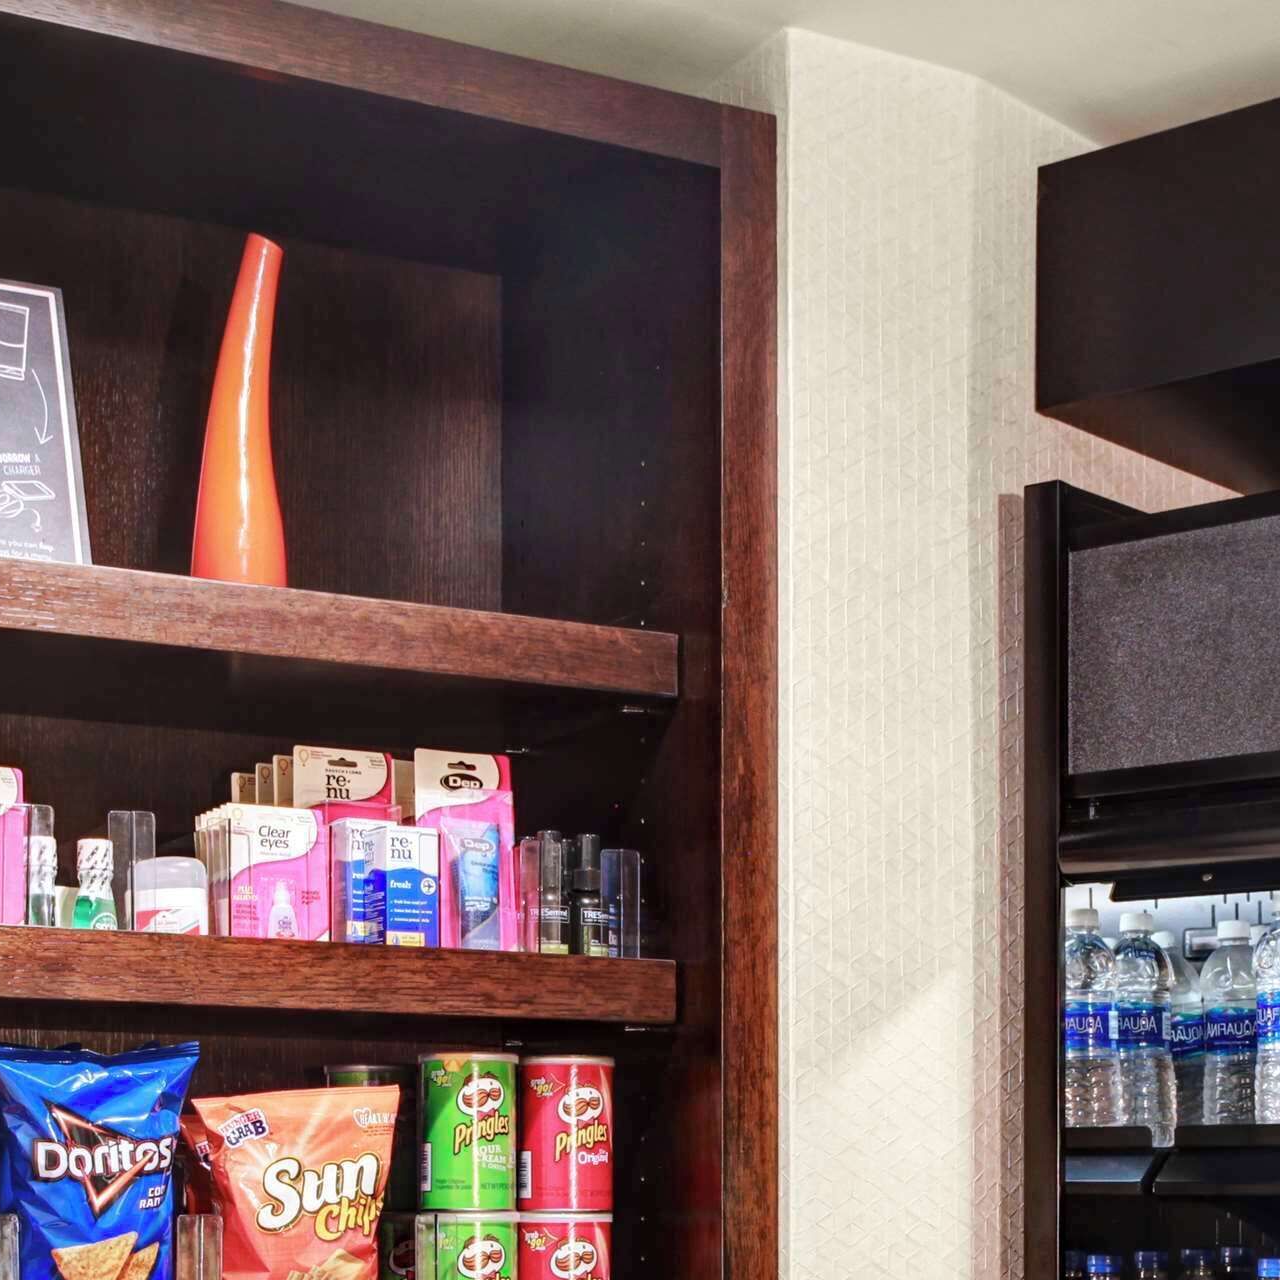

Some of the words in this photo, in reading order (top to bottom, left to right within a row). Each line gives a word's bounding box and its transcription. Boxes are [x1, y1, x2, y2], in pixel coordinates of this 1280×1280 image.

[3, 464, 41, 476] CHARGER
[326, 786, 351, 800] nu
[258, 825, 291, 839] Clear
[260, 838, 290, 851] eyes
[391, 850, 413, 861] nu
[226, 1120, 267, 1145] GRAB
[453, 1111, 509, 1155] Prngles
[36, 1138, 173, 1179] Doritos
[258, 1152, 381, 1231] Sun
